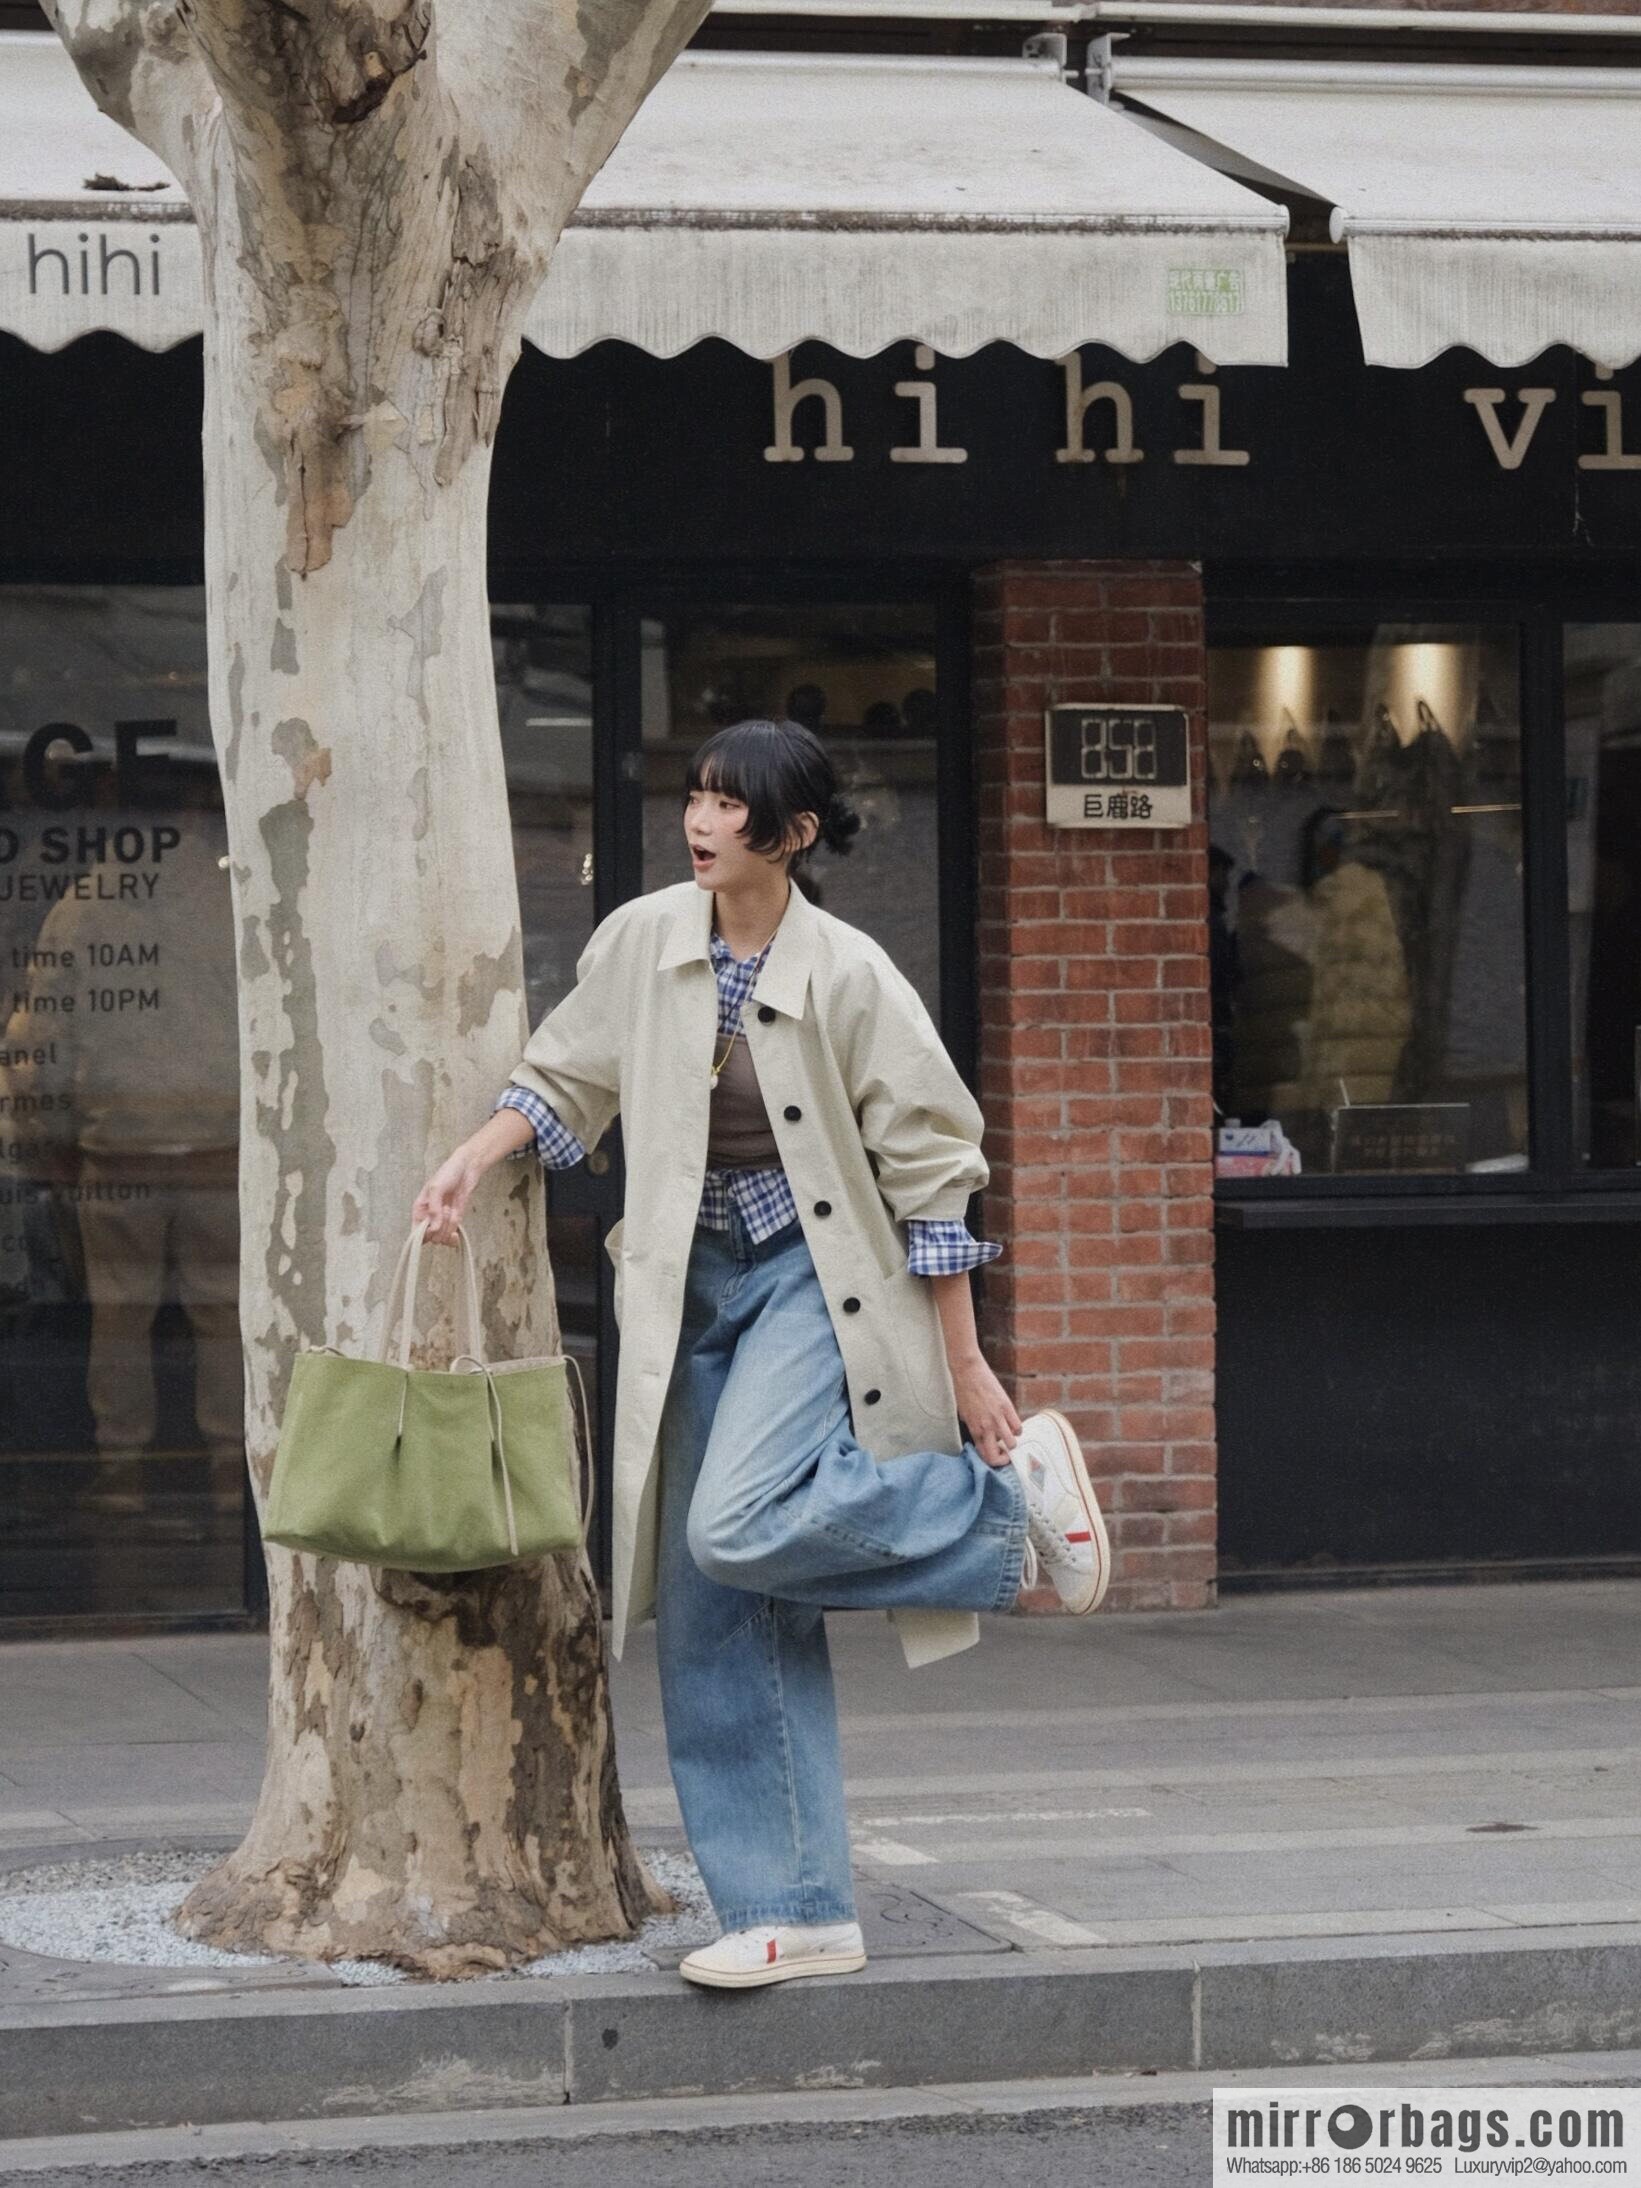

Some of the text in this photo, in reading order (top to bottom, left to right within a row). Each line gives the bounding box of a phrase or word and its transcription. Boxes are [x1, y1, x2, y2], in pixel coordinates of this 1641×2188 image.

[28, 232, 160, 295] hihi
[0, 718, 177, 812] GE
[1081, 718, 1157, 780] 858
[1084, 793, 1152, 819] 巨鹿路
[39, 826, 181, 864] SHOP
[0, 873, 159, 901] JEWELRY
[12, 942, 160, 969] time 10AM
[13, 987, 160, 1013] time 10PM
